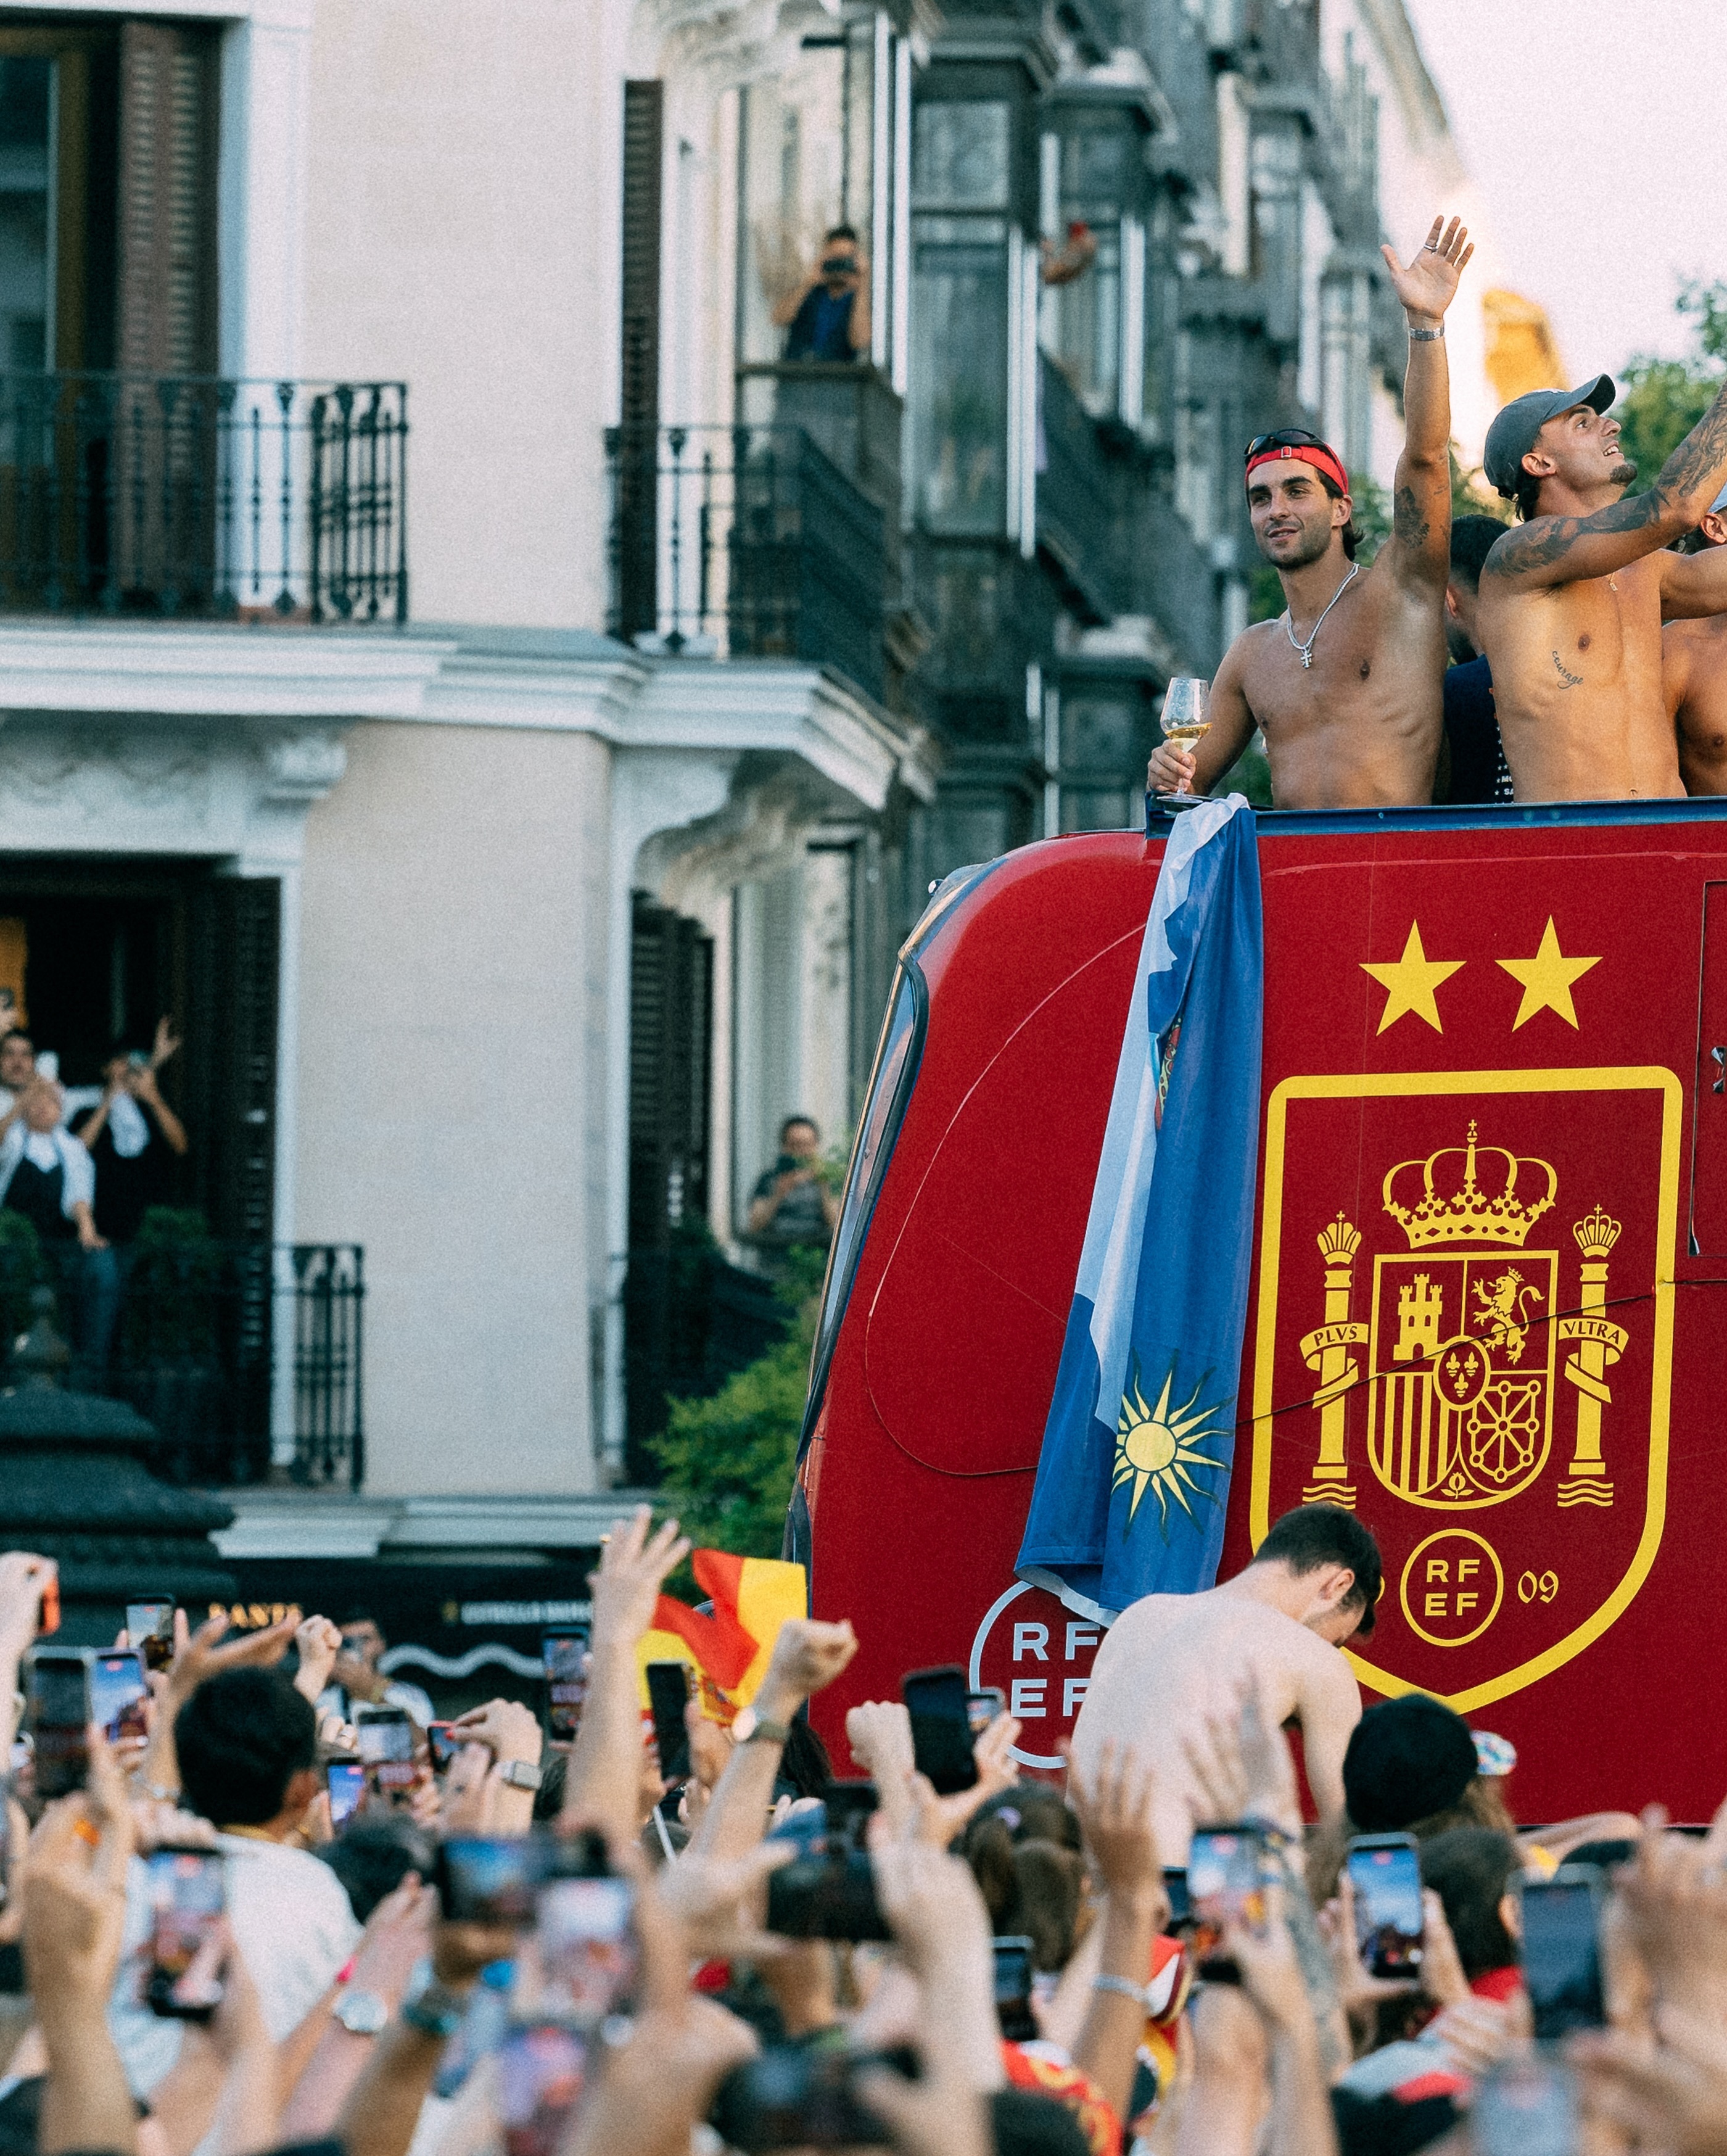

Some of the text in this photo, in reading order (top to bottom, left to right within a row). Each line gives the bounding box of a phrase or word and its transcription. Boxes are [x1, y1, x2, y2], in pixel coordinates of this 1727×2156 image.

[1552, 650, 1584, 690] courage
[1313, 1325, 1358, 1347] PLVS
[1563, 1321, 1620, 1345] VLTRA
[1517, 1570, 1559, 1604] 09
